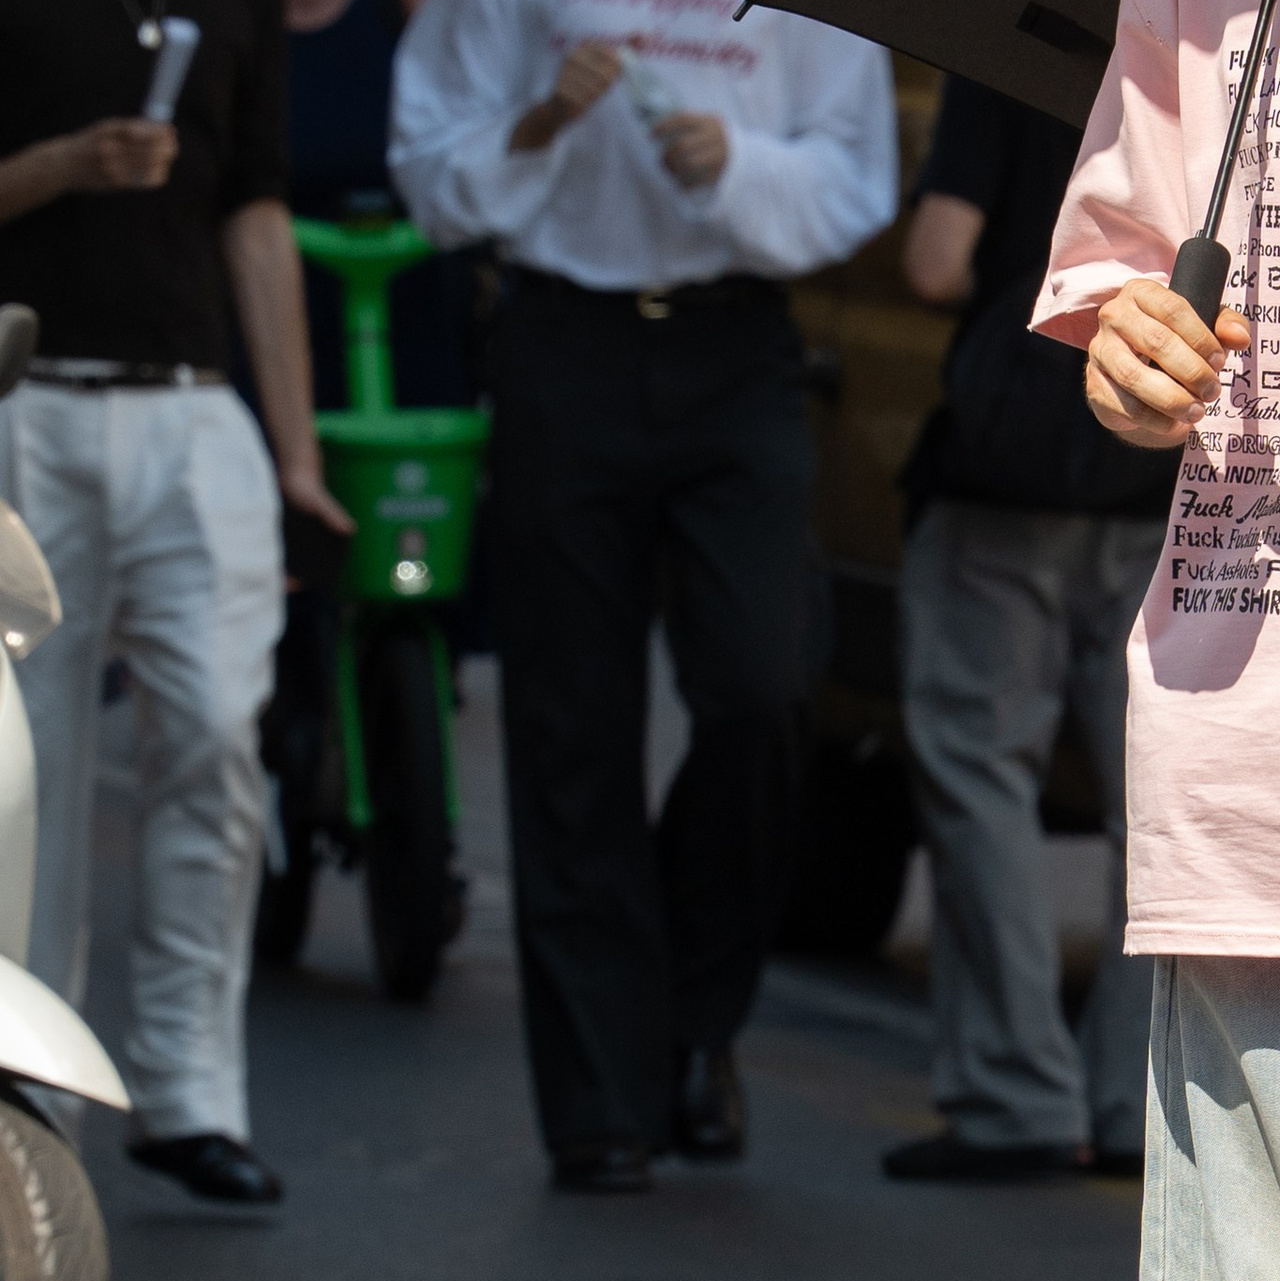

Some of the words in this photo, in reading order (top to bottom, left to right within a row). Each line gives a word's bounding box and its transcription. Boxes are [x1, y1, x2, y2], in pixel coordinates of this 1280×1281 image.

[1181, 462, 1219, 485] FUCK
[1180, 489, 1234, 520] Fuck
[1173, 524, 1225, 551] Fuck
[1173, 586, 1212, 614] FUCK
[1211, 586, 1238, 614] THIS
